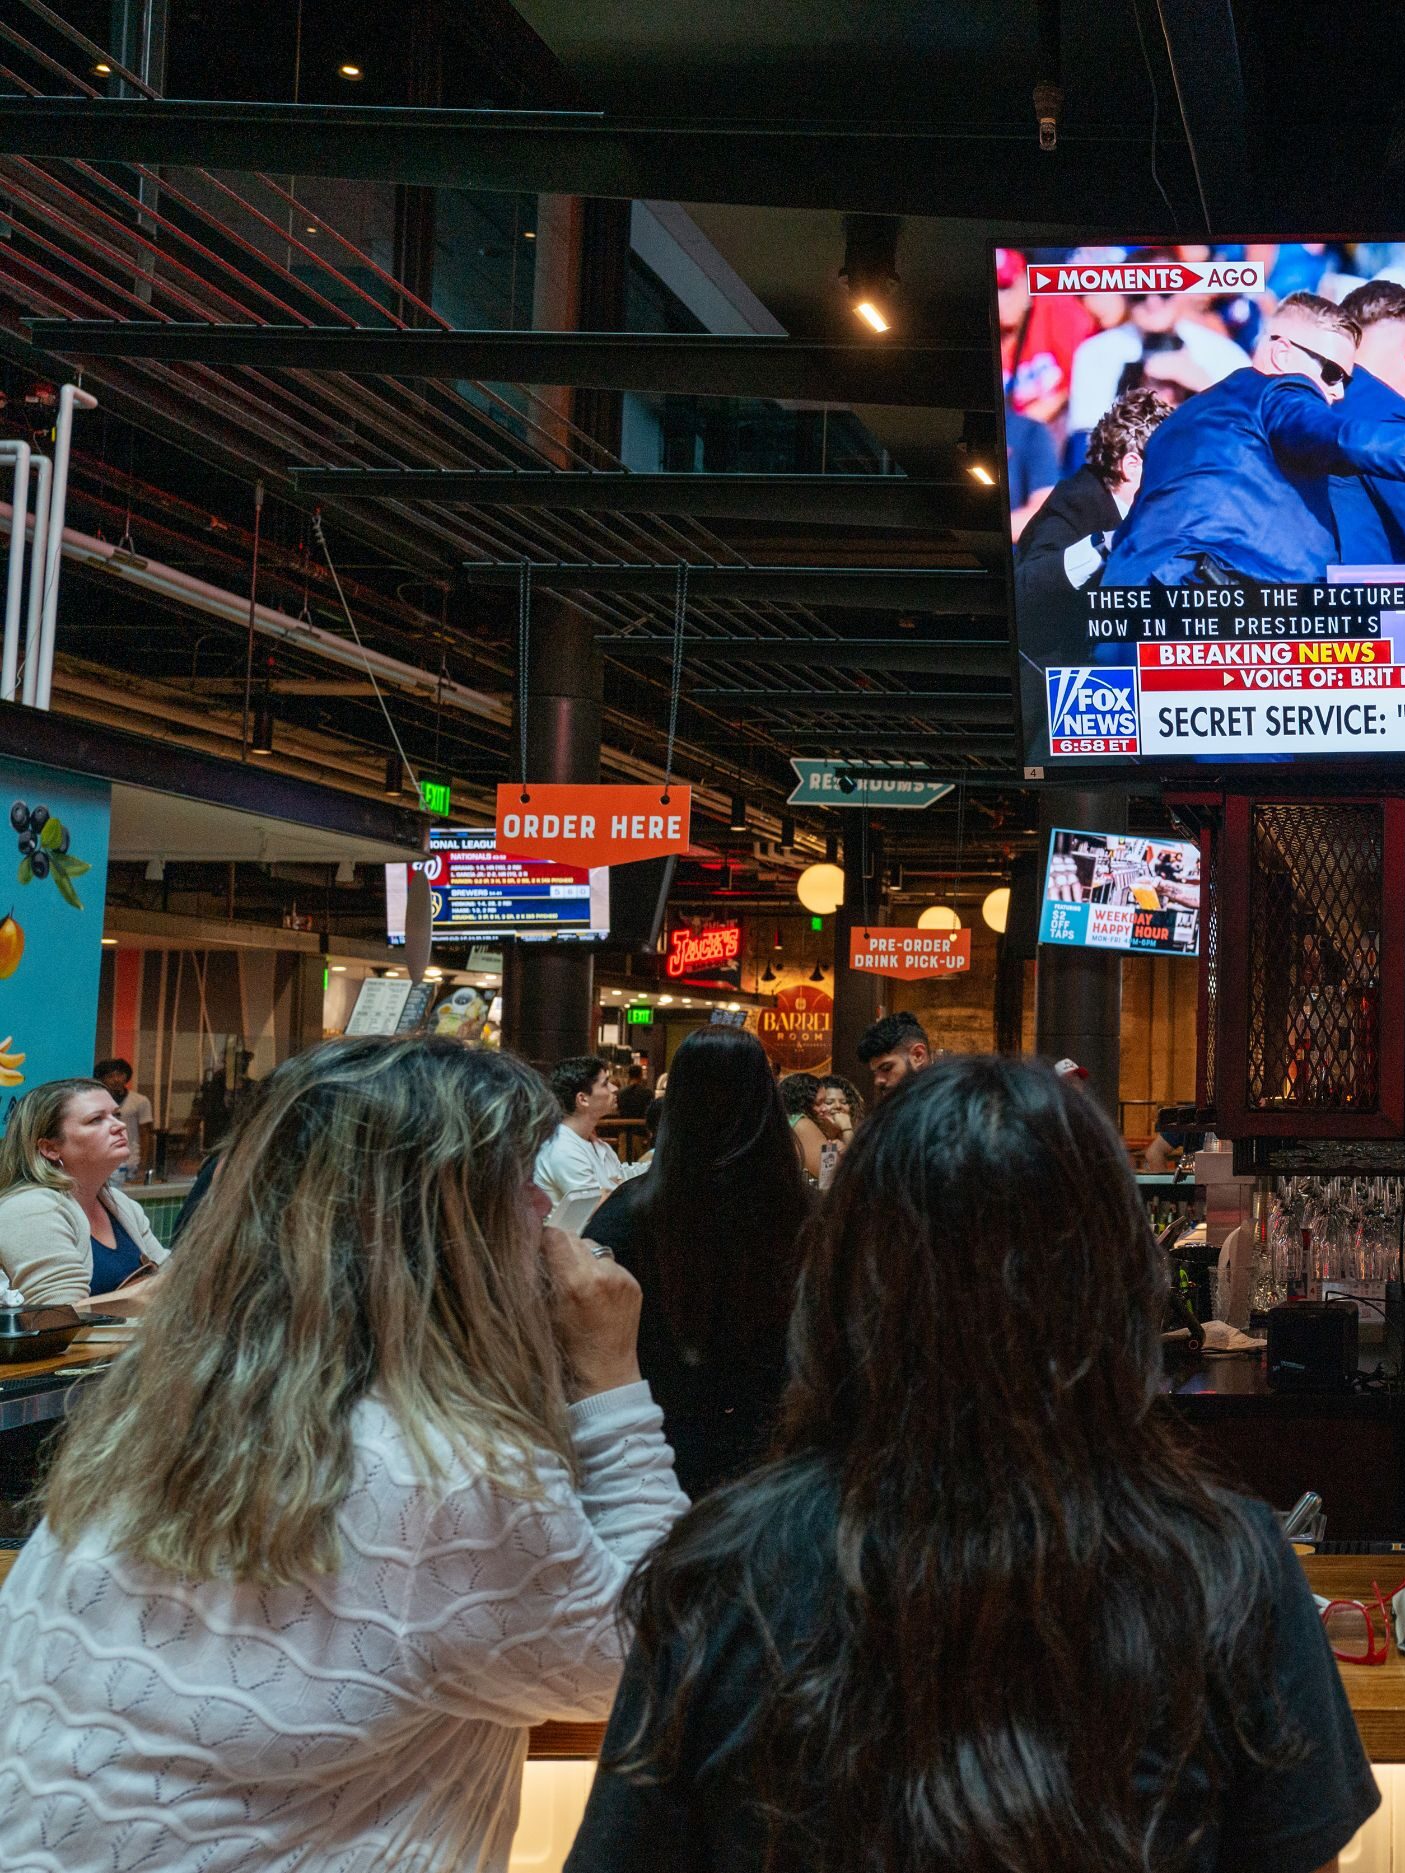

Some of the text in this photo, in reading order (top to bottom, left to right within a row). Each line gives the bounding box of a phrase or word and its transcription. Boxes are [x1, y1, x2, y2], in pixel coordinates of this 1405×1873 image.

[1057, 268, 1258, 290] MOMENTS AGO
[1087, 591, 1152, 609] THESE
[1166, 590, 1245, 608] VIDEOS
[1260, 589, 1298, 607] THE
[1088, 616, 1379, 637] NOW IN THE PRESIDENT'S
[1159, 642, 1375, 665] BREAKING NEWS
[1240, 668, 1303, 688] VOICE
[1309, 668, 1344, 687] OF:
[1350, 667, 1394, 686] BRIT
[1077, 687, 1132, 711] FOX
[1063, 713, 1135, 735] NEWS
[1158, 706, 1256, 738] SECRET
[1265, 704, 1387, 737] SERVICE:
[1060, 739, 1130, 752] 6:58 ET
[1030, 769, 1037, 778] 4
[503, 814, 682, 839] ORDER HERE
[1051, 919, 1071, 930] OFF
[1095, 909, 1154, 925] WEEKDAY
[1050, 928, 1075, 940] TAPS
[1092, 922, 1169, 941] HAPPY HOUR
[869, 938, 951, 953] PRE-ORDER
[854, 954, 965, 969] DRINK PICK-UP
[777, 1032, 823, 1041] ROOM
